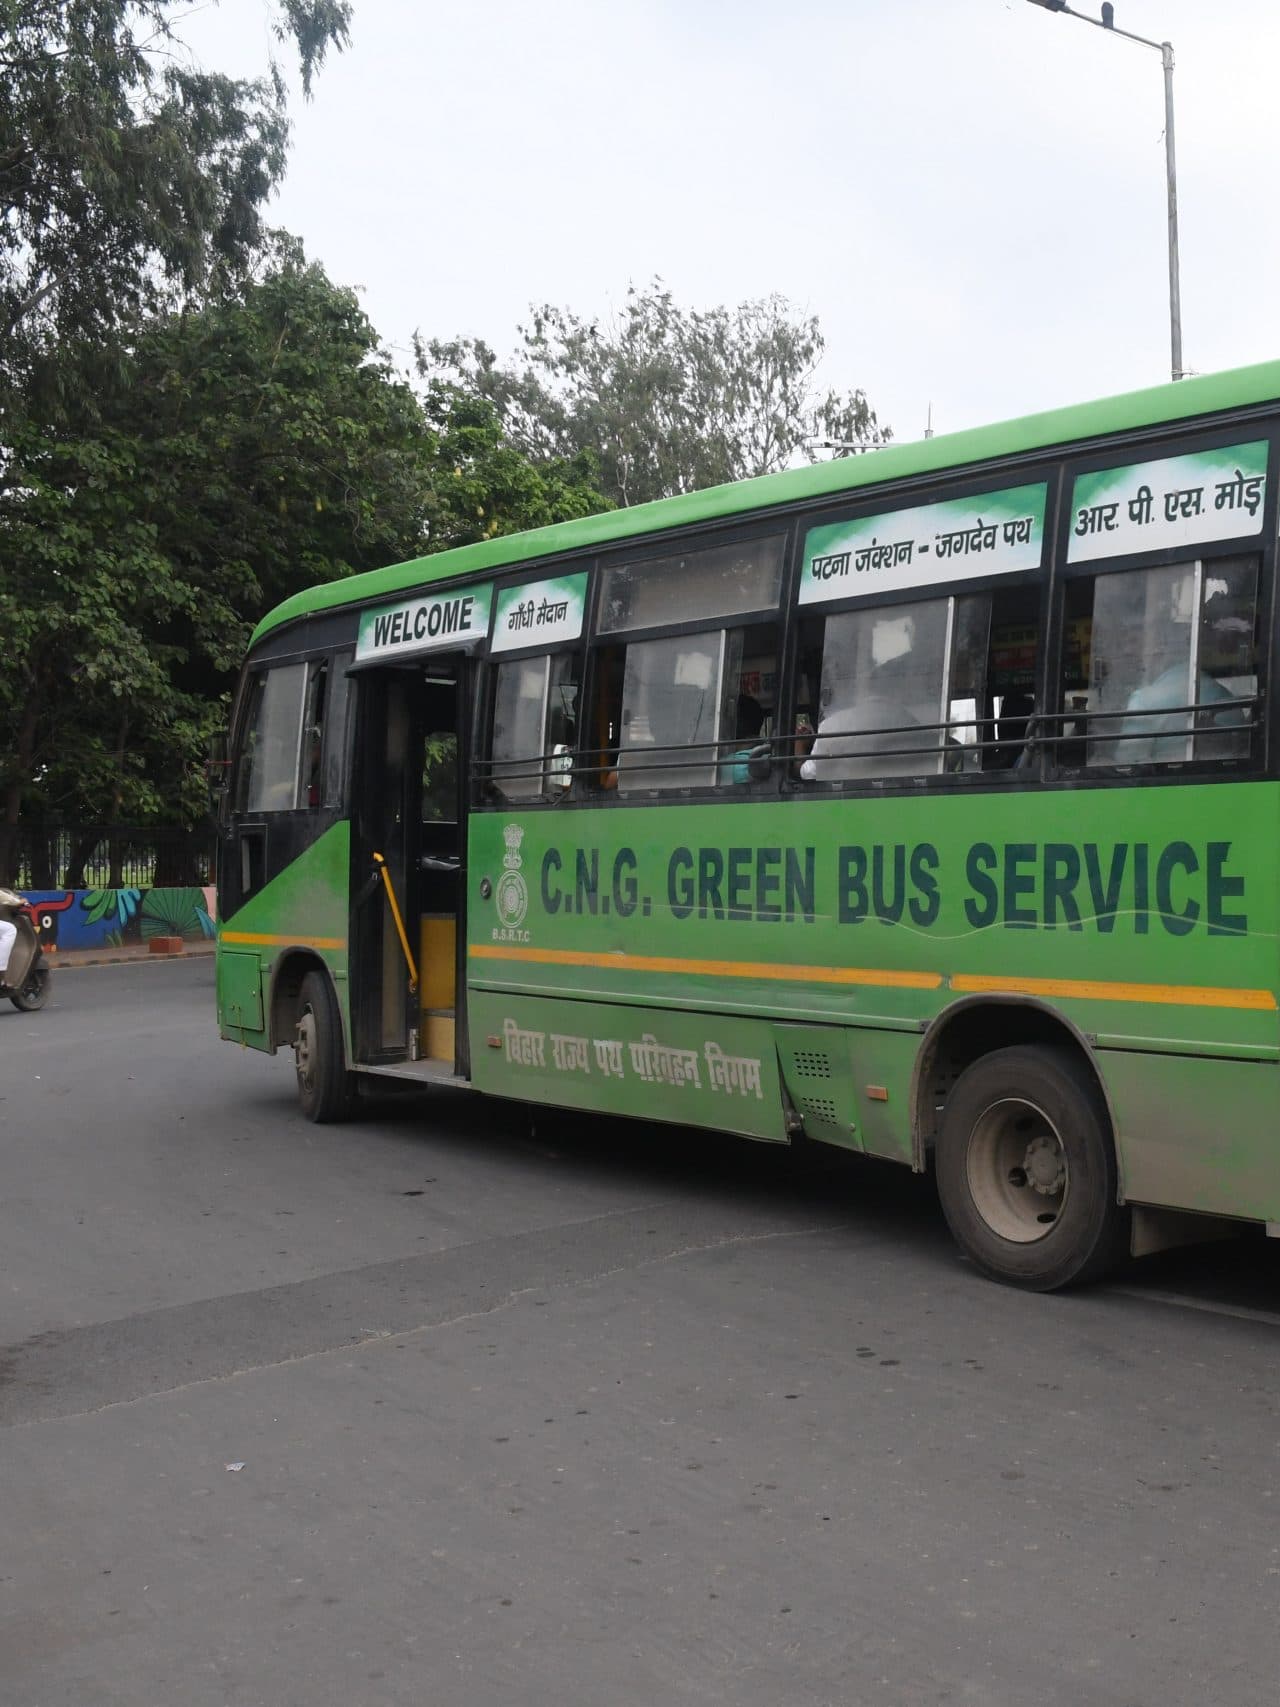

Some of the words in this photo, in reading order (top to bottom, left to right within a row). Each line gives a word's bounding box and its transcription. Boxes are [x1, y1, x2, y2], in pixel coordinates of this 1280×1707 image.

[1074, 501, 1120, 537] आर.
[1128, 485, 1156, 525] पी.
[1164, 487, 1206, 521] एस.
[1213, 469, 1266, 517] मोड़
[811, 549, 852, 582] पटना
[855, 537, 913, 573] जंक्शन
[935, 518, 999, 559] जगदेव
[1003, 516, 1034, 545] पथ
[374, 596, 476, 648] WELCOME
[507, 600, 535, 632] गाँधी
[536, 597, 569, 627] मैदान
[541, 847, 651, 917] C.N.G.
[667, 846, 816, 924] GREEN
[838, 842, 941, 927] BUS
[964, 841, 1248, 937] SERVICE
[503, 1018, 546, 1067] बिहार
[550, 1033, 590, 1074] राज्य
[593, 1039, 625, 1078] पथ
[628, 1033, 702, 1089] परिवहन
[704, 1041, 763, 1099] निगम
